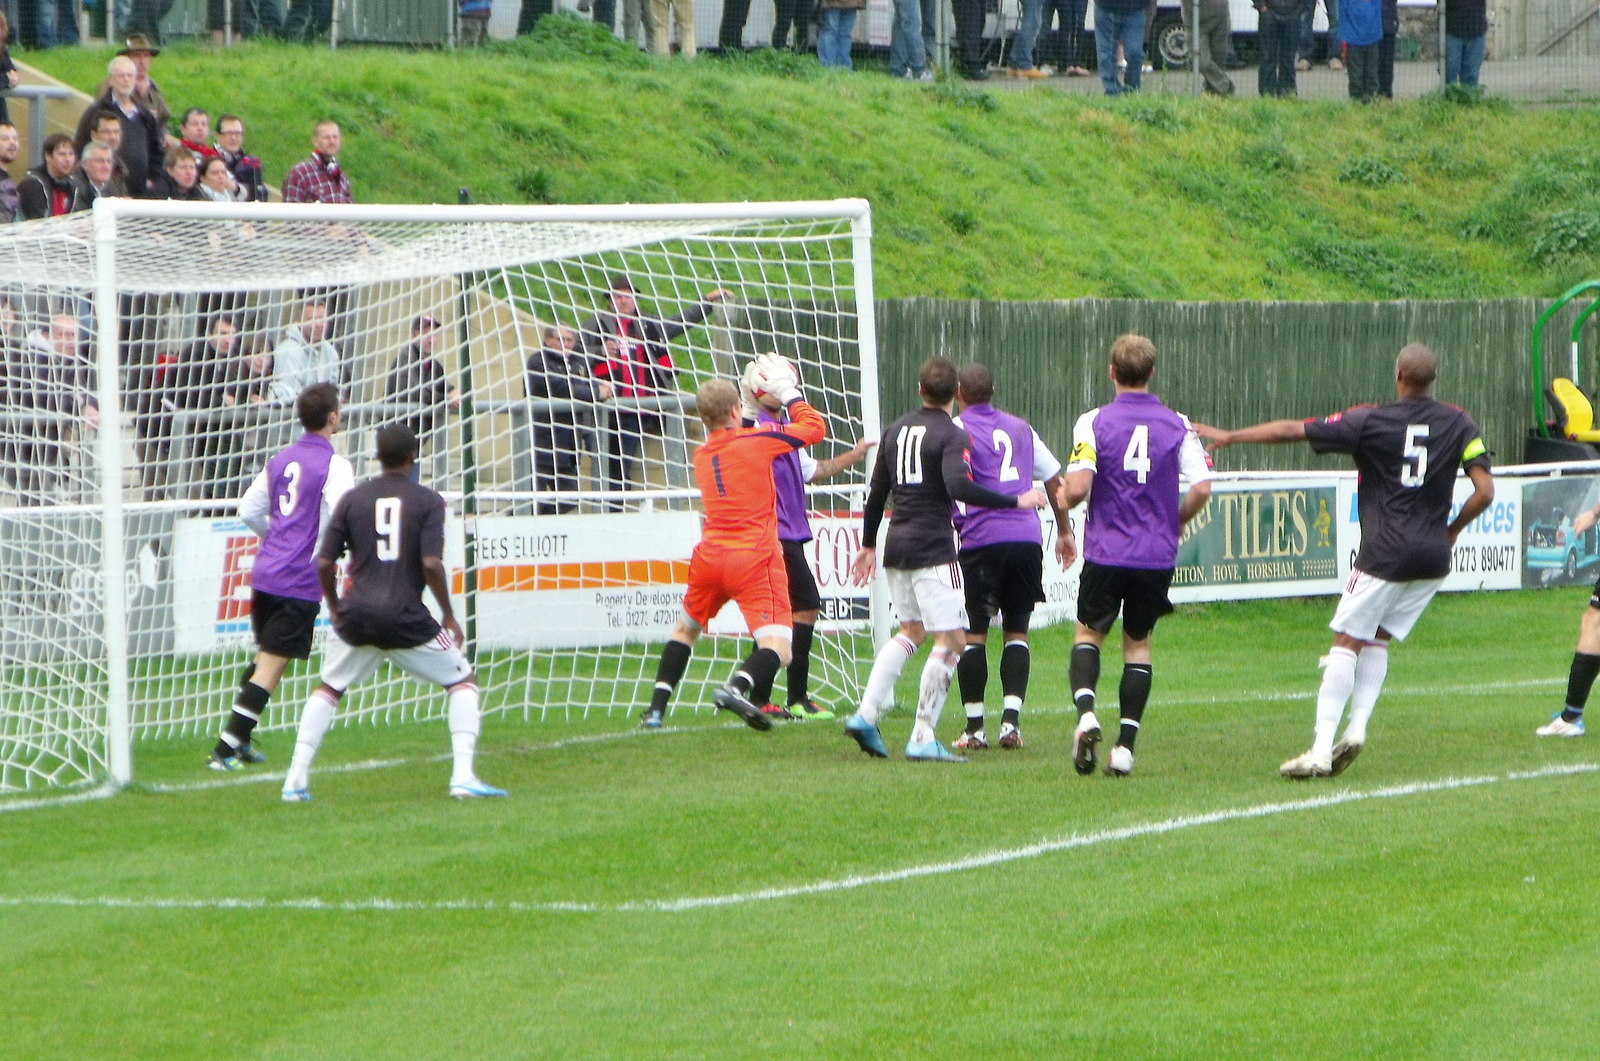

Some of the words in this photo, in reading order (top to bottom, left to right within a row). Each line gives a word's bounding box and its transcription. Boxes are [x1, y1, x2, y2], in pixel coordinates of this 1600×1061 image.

[711, 455, 726, 497] 1
[896, 425, 926, 484] 10
[993, 429, 1019, 482] 2
[1123, 425, 1151, 484] 4
[1401, 424, 1429, 487] 5
[278, 461, 301, 517] 3
[375, 497, 401, 562] 9
[514, 534, 568, 558] ELLIOTT
[1218, 490, 1308, 560] TILES
[1213, 563, 1242, 583] HOVE,
[1247, 560, 1297, 581] HORSHAM,
[1449, 549, 1476, 574] 1273
[1481, 547, 1516, 572] 890477
[595, 592, 633, 610] Property
